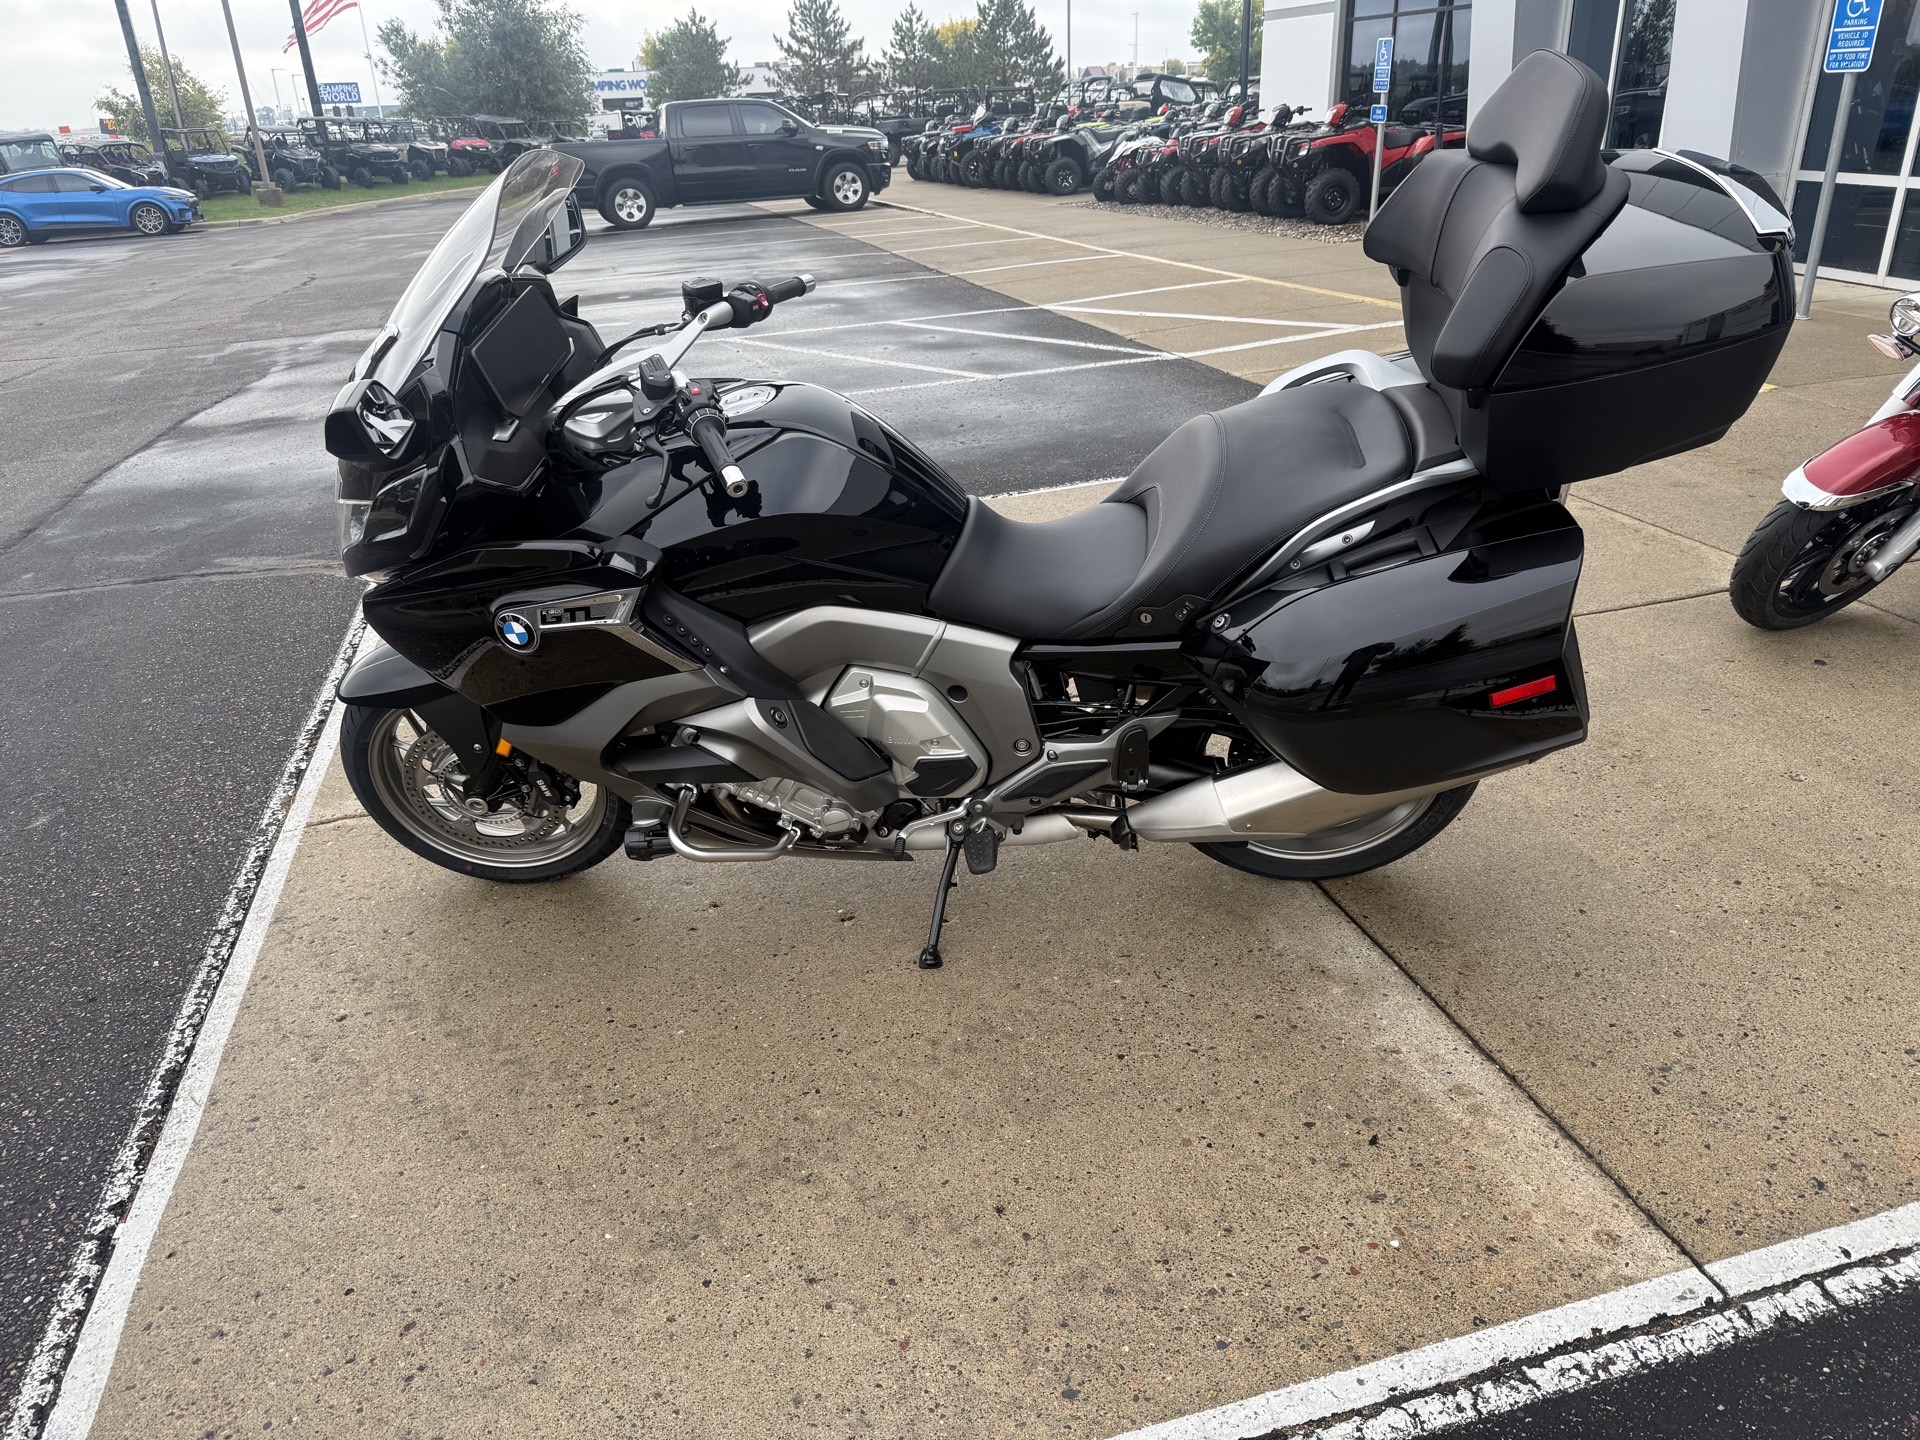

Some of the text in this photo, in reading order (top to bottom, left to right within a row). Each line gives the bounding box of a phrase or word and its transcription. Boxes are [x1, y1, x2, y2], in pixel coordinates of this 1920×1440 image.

[1843, 18, 1868, 26] PARKING
[320, 84, 358, 94] CAMPING
[322, 92, 359, 102] WORLD
[498, 614, 528, 628] BMW
[536, 779, 553, 797] BMW
